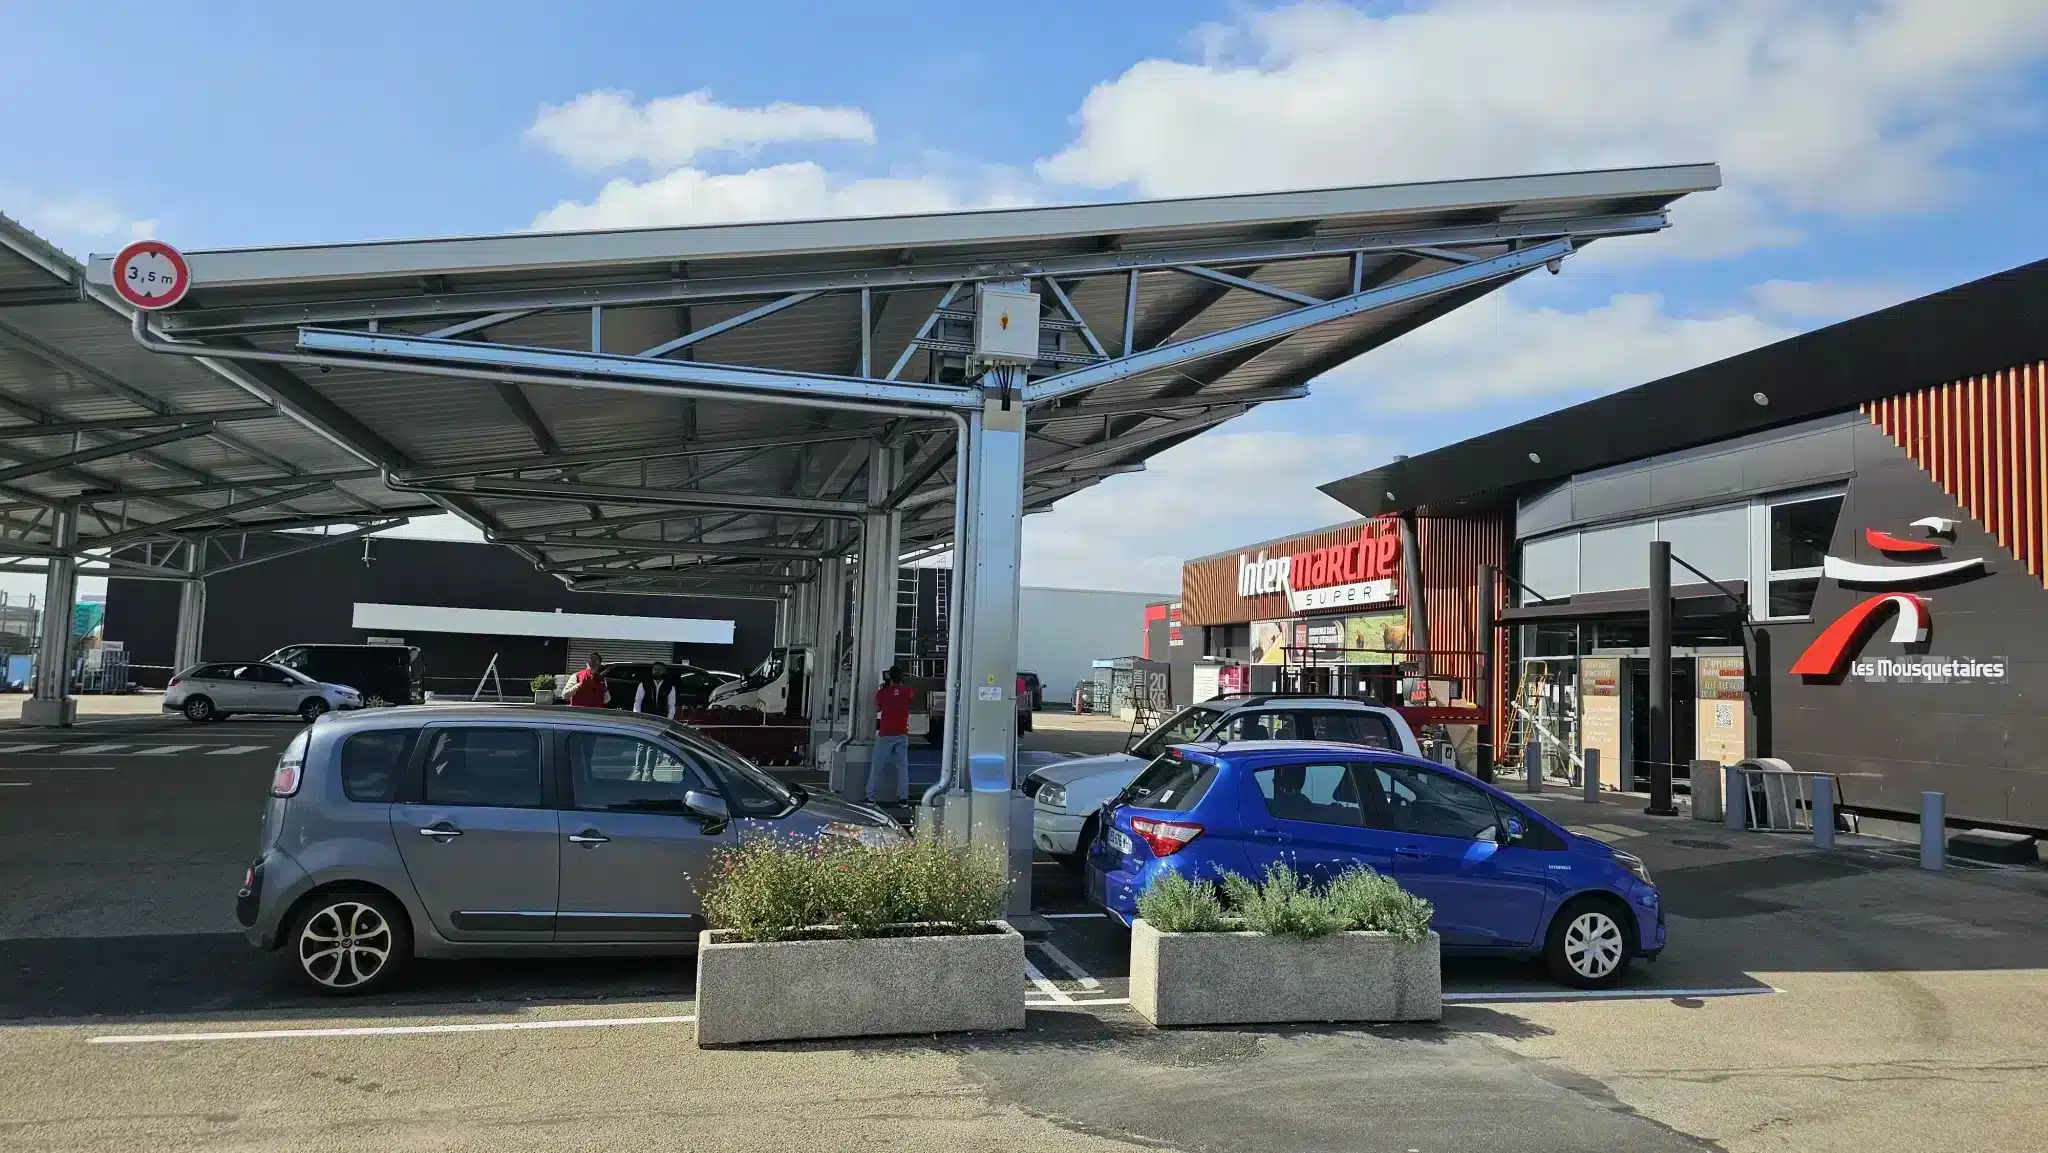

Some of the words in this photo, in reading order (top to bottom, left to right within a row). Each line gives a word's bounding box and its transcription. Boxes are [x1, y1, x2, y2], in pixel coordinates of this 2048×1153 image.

[128, 266, 156, 283] 3,5
[161, 275, 173, 285] m
[1238, 523, 1399, 597] Intermarché
[1306, 586, 1372, 606] SUPER
[1851, 660, 1875, 677] les
[1877, 659, 2004, 681] Mousquetaires
[1150, 672, 1167, 692] 20
